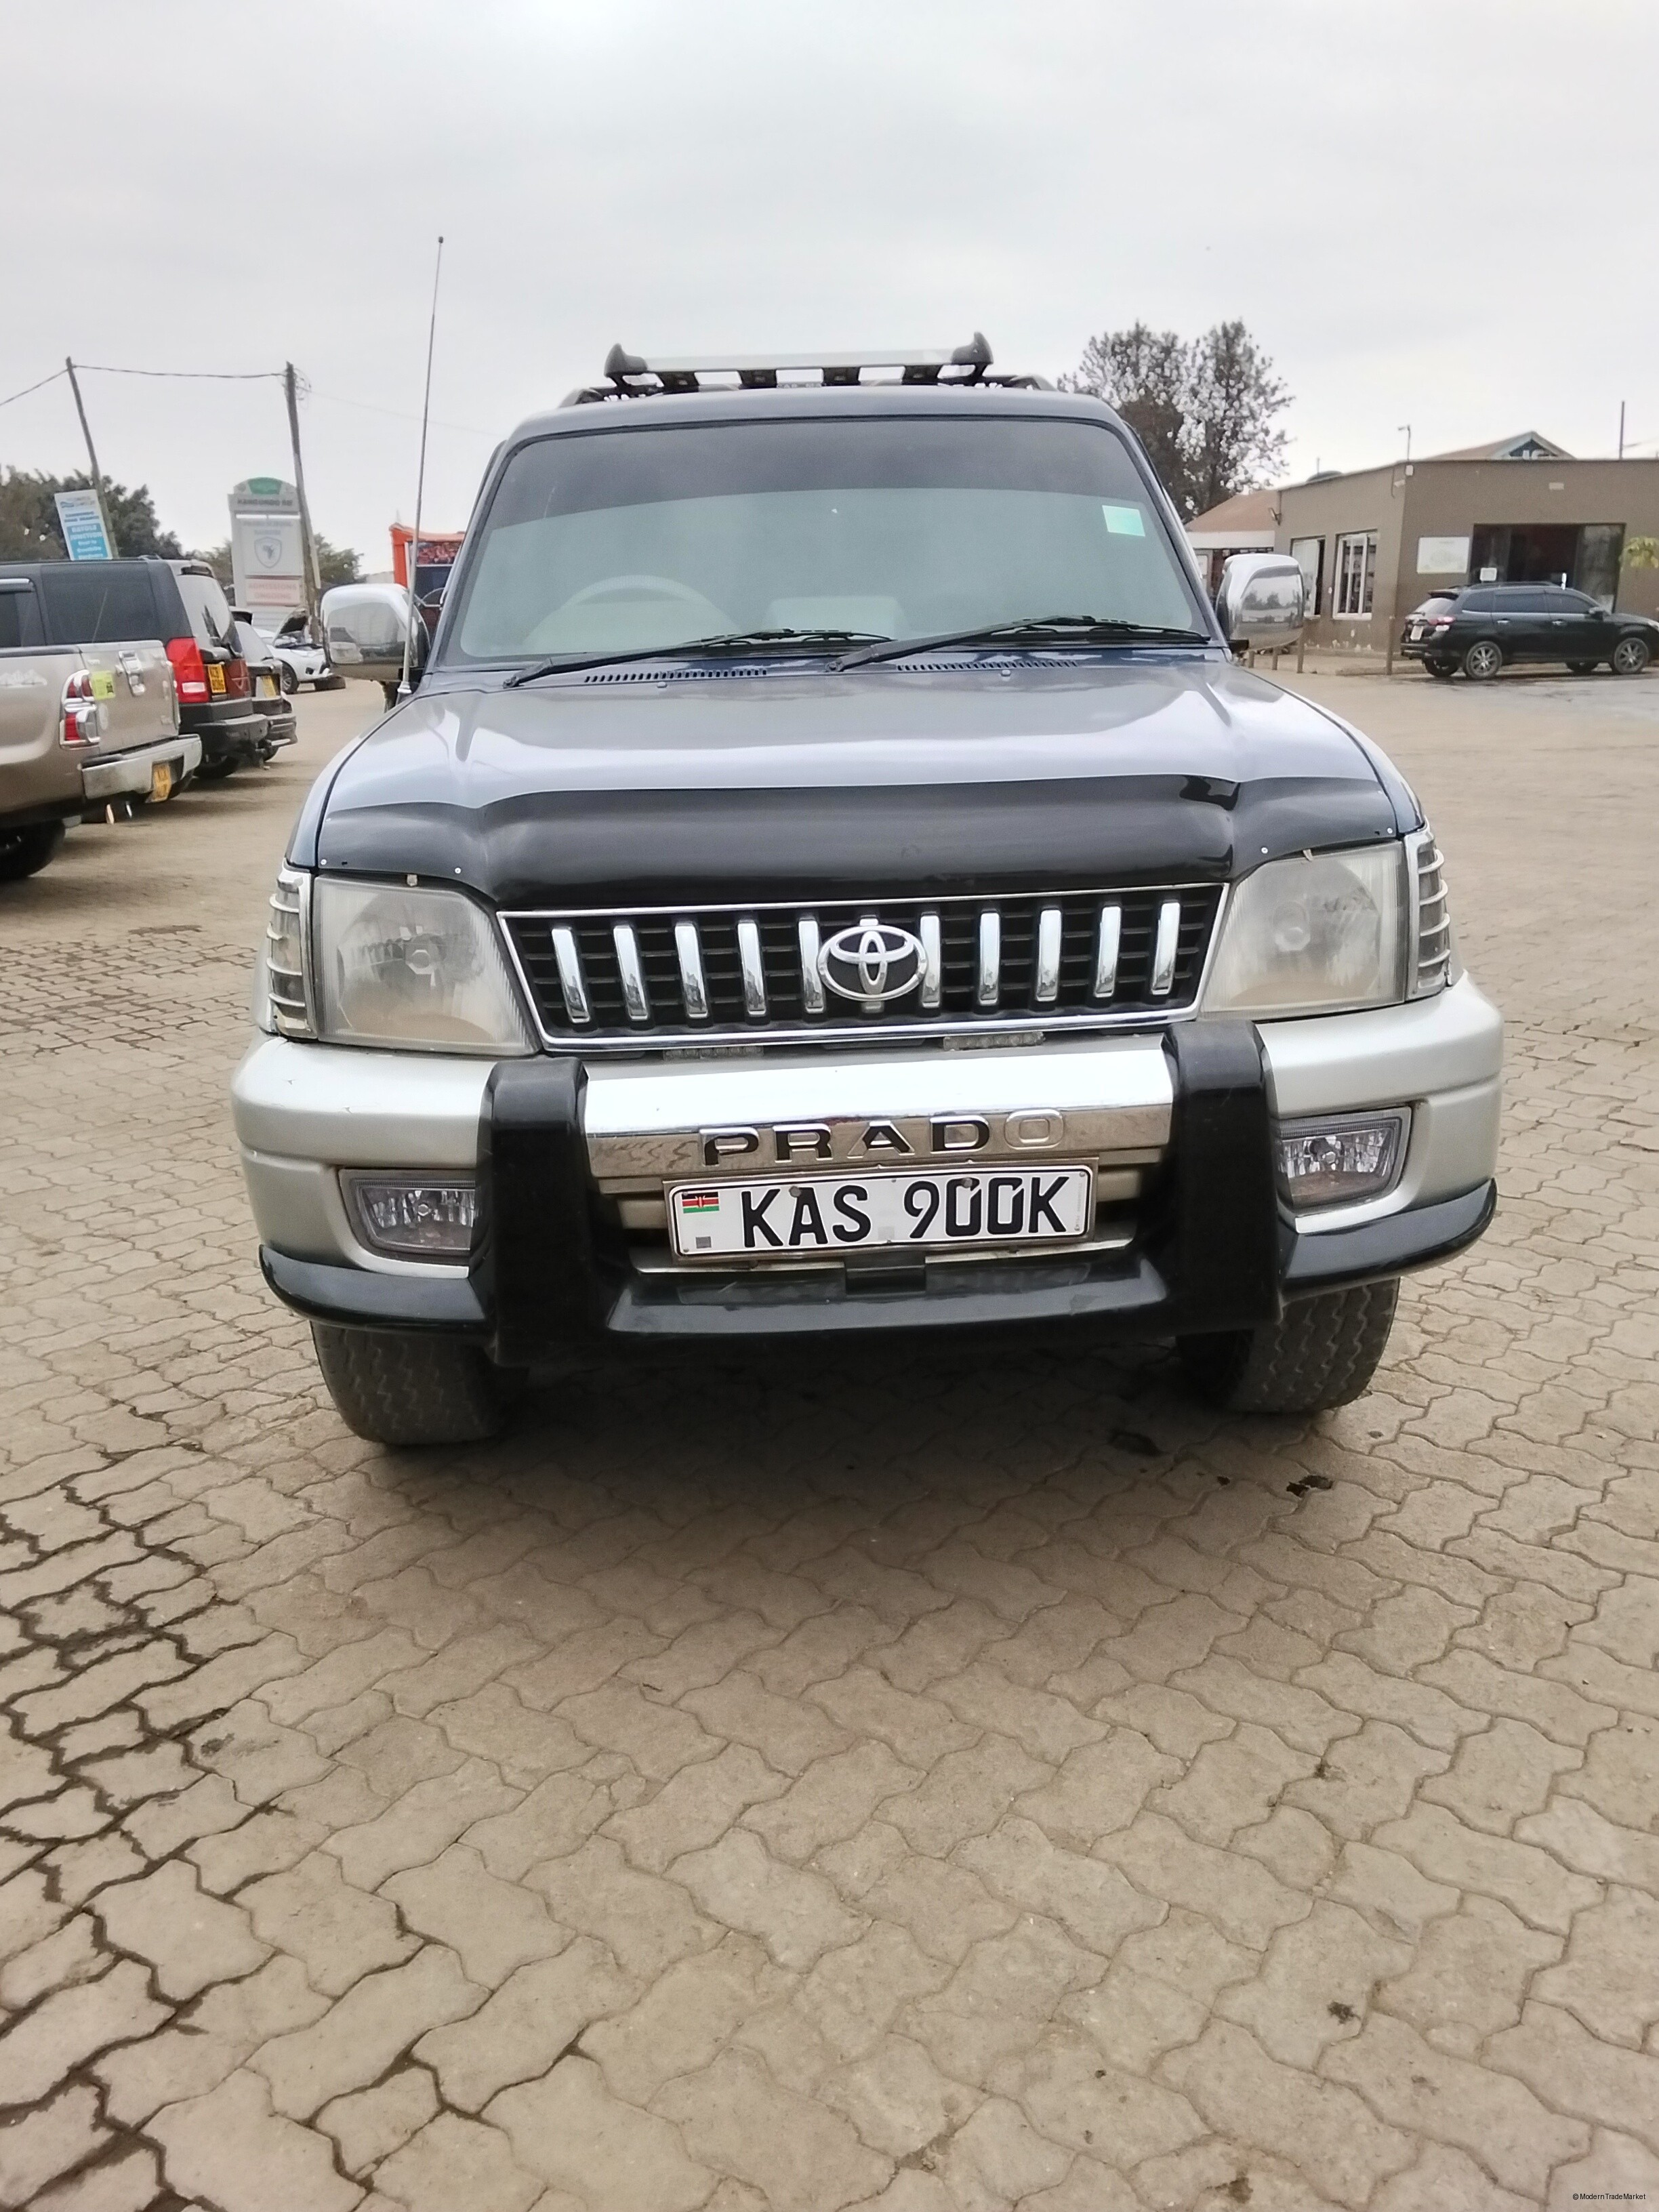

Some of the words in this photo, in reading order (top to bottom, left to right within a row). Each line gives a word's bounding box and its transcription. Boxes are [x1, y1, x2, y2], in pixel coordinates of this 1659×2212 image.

[699, 1107, 1065, 1166] PRADO
[741, 1185, 872, 1248] KAS
[903, 1176, 1070, 1239] 900K
